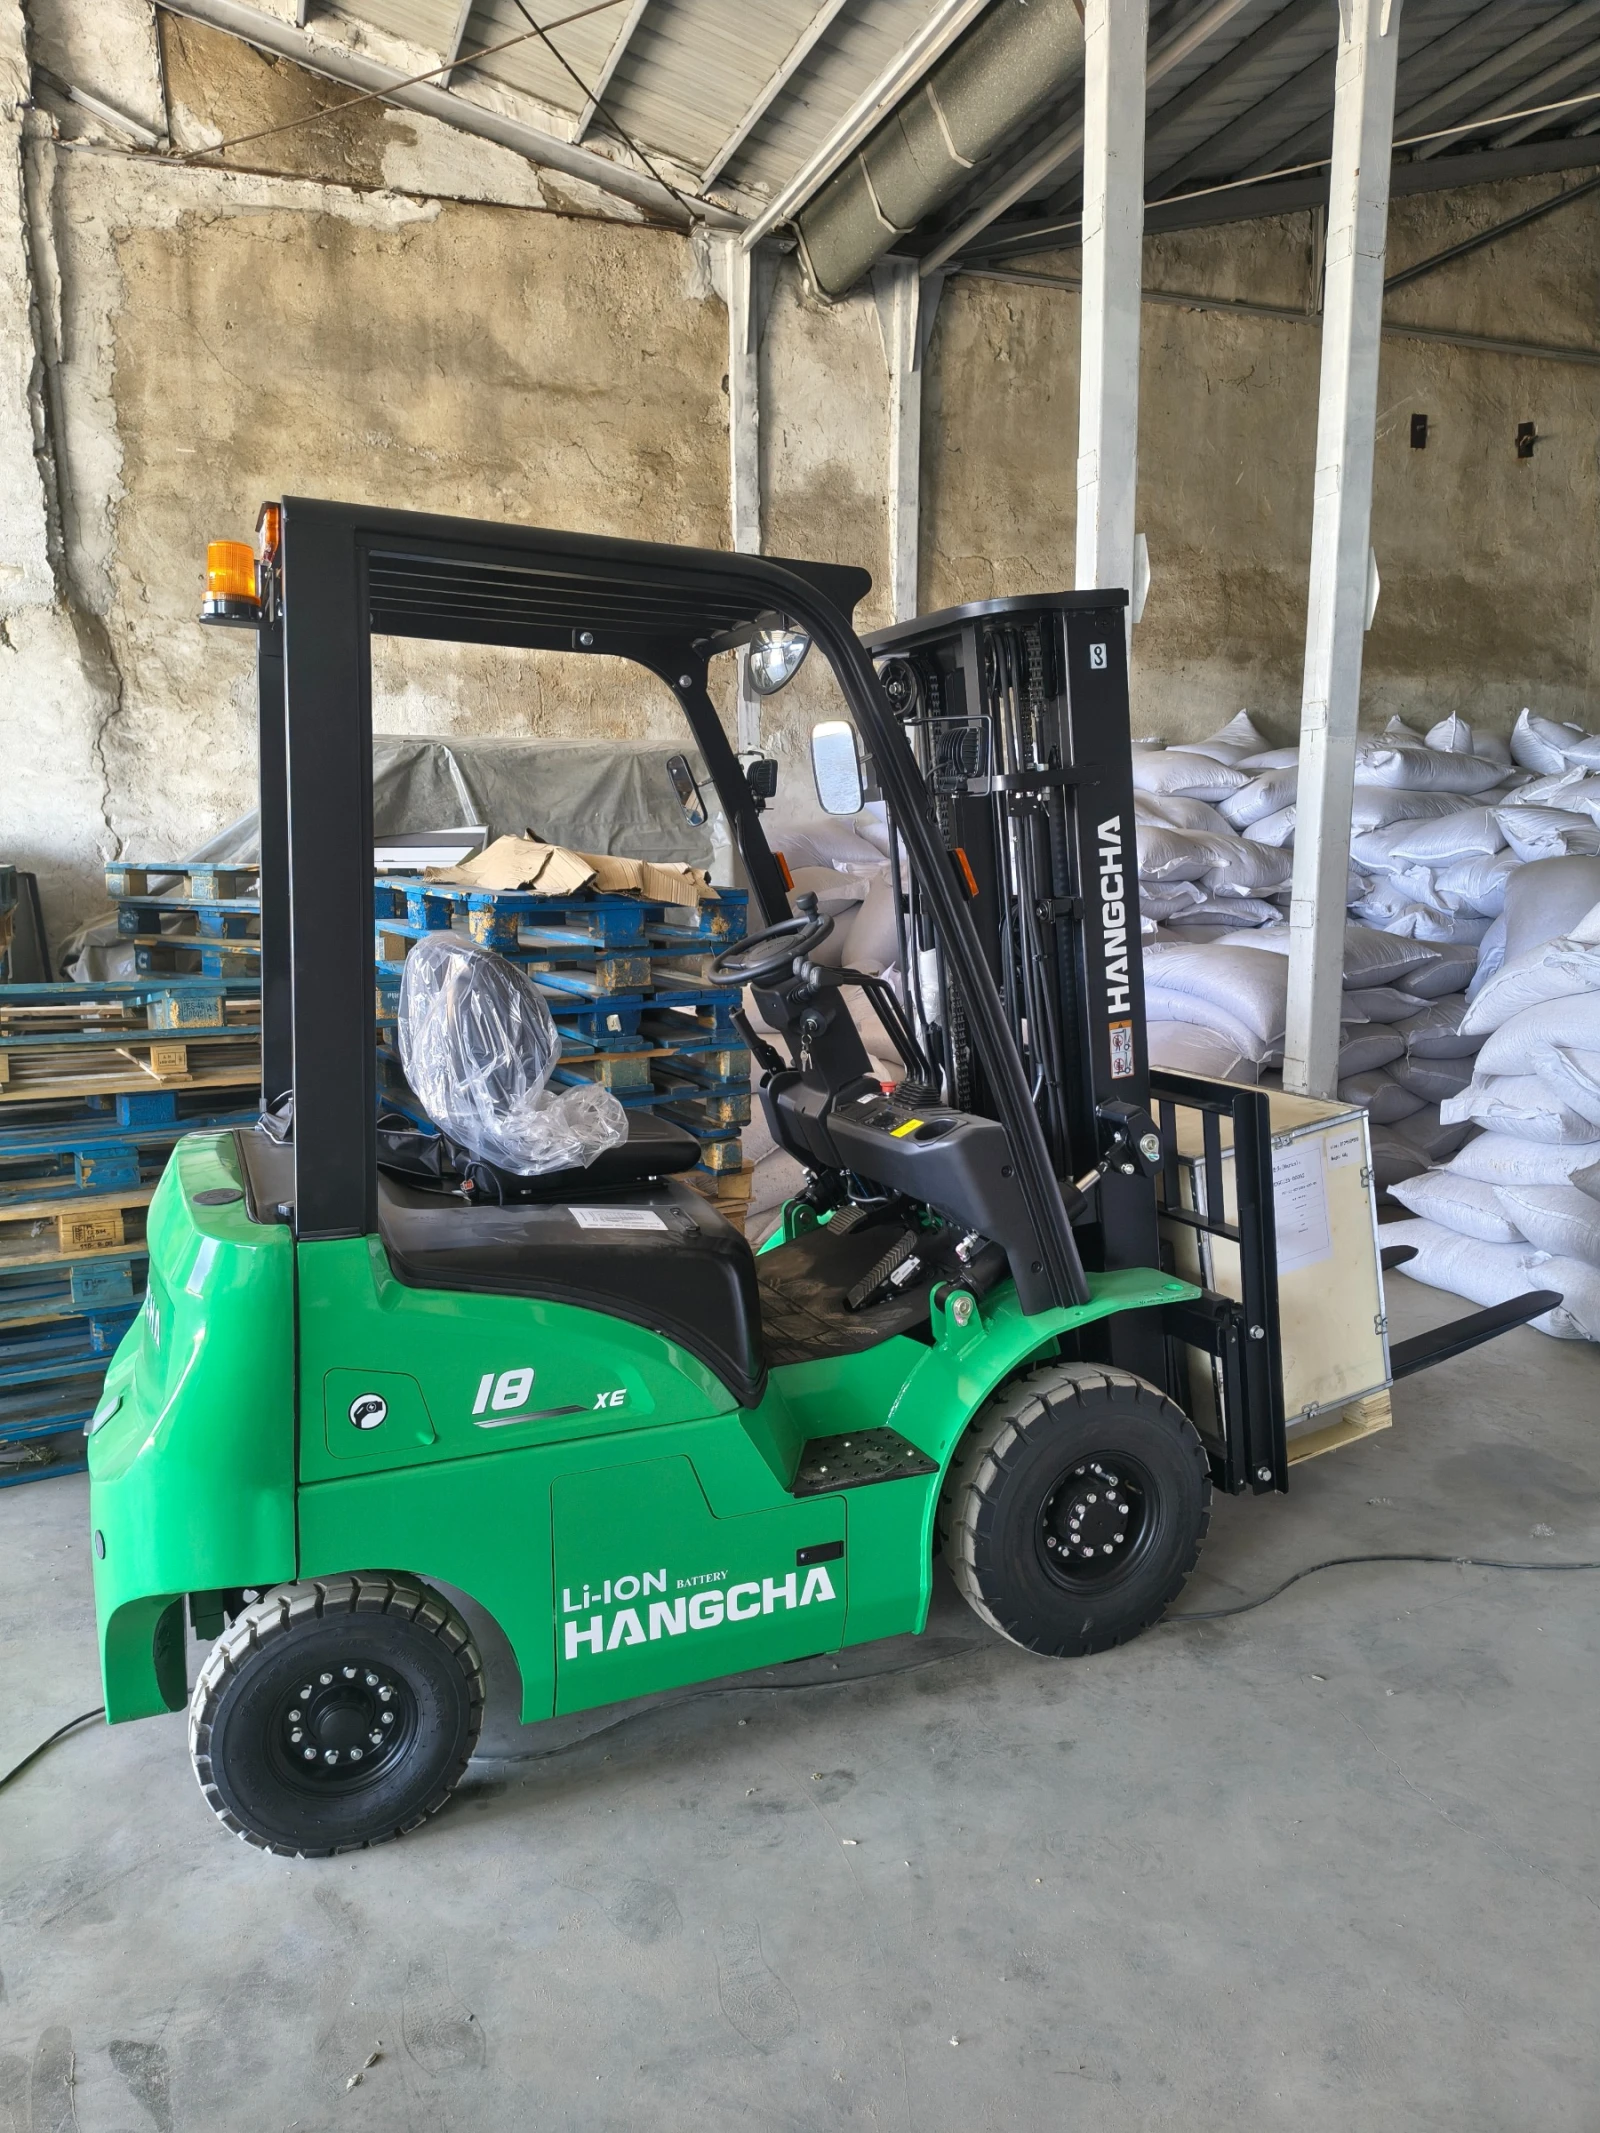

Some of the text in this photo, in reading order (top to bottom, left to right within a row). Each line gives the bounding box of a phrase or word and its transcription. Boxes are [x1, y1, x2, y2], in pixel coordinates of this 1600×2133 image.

[1097, 815, 1131, 1014] HANGCHA
[472, 1367, 534, 1415] 18
[593, 1388, 627, 1410] XE
[563, 1568, 728, 1613] Li-ION BATTERY
[564, 1566, 836, 1660] HANGCHA
